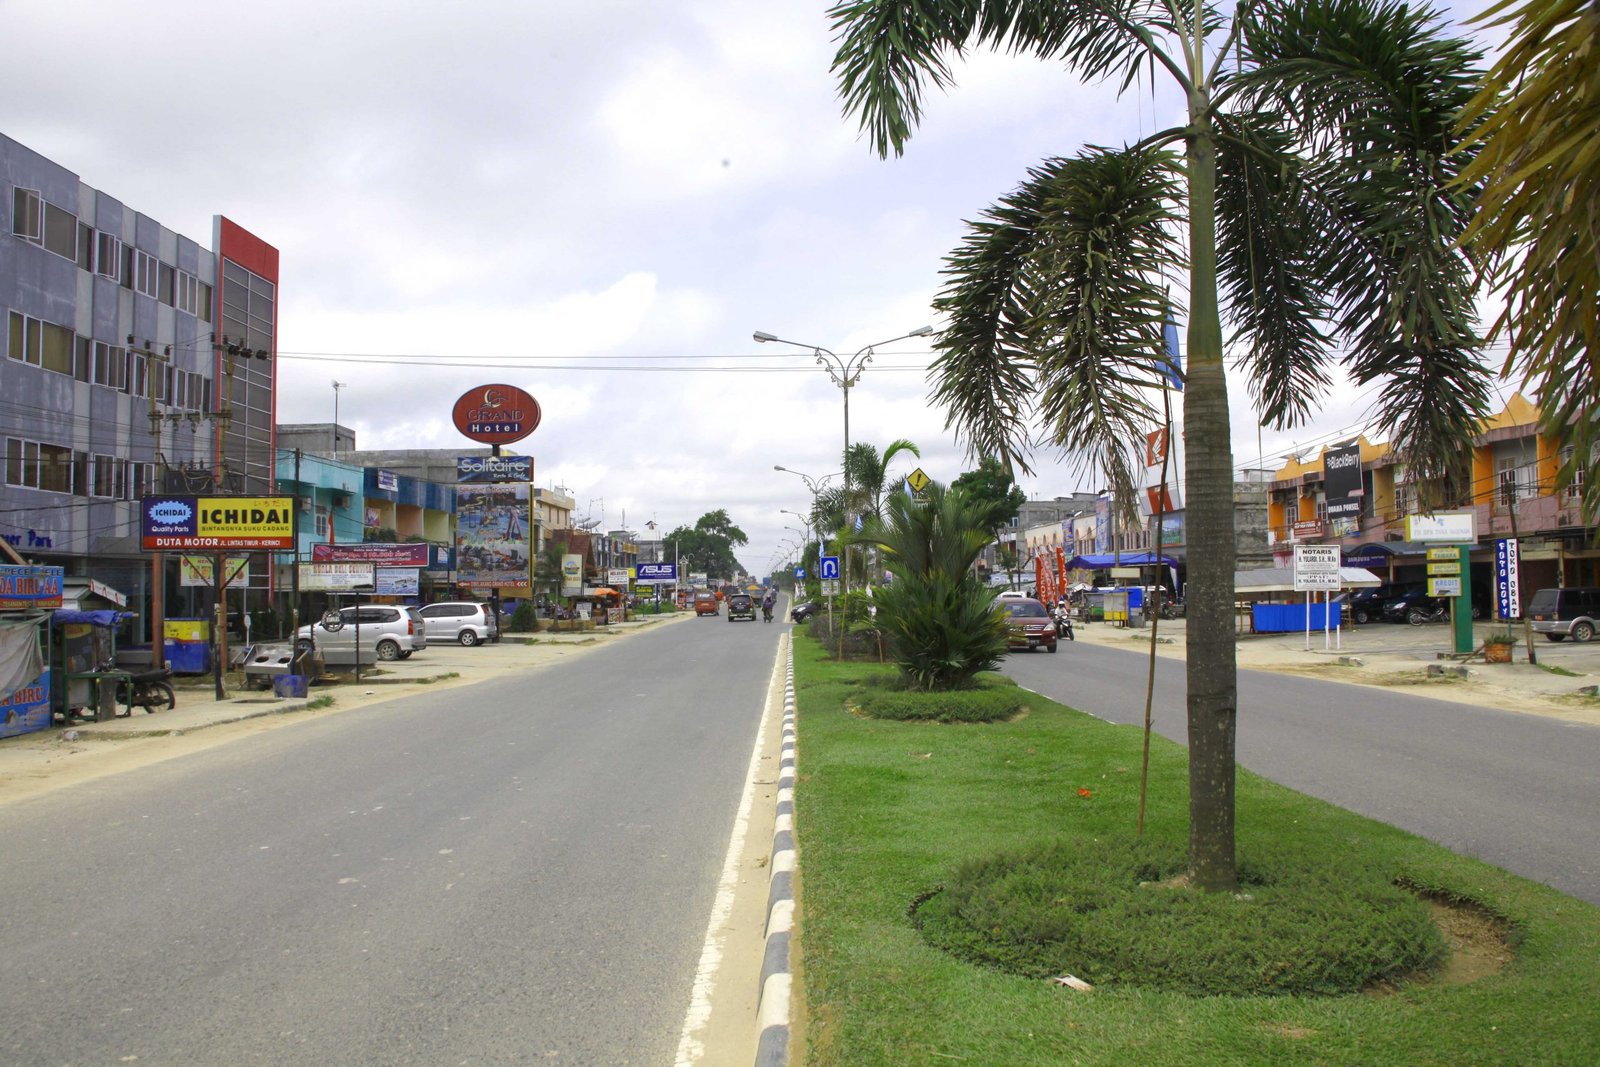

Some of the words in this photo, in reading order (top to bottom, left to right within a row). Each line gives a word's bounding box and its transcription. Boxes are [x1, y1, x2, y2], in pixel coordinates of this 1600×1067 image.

[468, 409, 525, 422] GRAND
[472, 424, 518, 432] Hotel
[461, 458, 525, 472] Solitaire
[1330, 453, 1360, 470] BlackBerry
[201, 509, 289, 524] ICHIDAI
[156, 538, 182, 546] DUTA
[184, 538, 218, 546] MOTOR
[1498, 542, 1506, 577] FOTO
[1508, 542, 1516, 575] TOKO
[640, 565, 672, 573] ASUS
[1500, 582, 1508, 615] COPY
